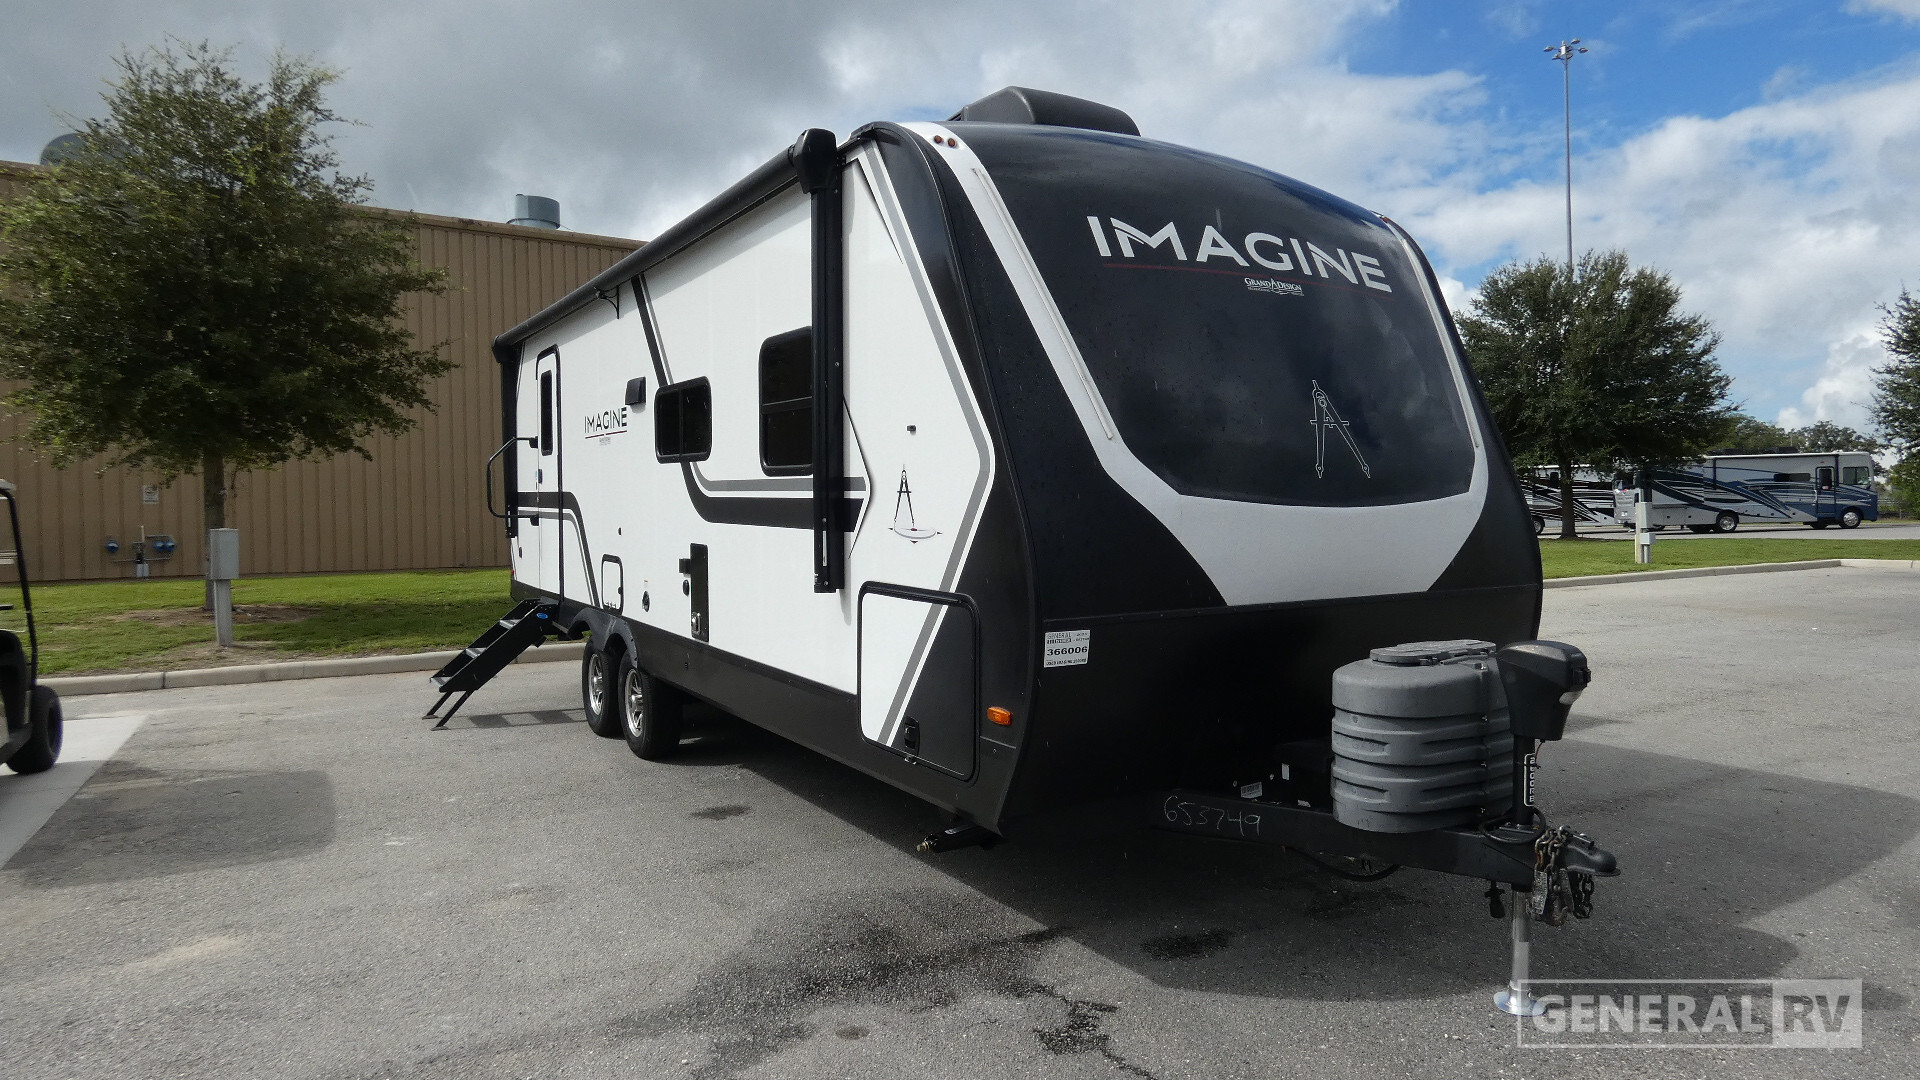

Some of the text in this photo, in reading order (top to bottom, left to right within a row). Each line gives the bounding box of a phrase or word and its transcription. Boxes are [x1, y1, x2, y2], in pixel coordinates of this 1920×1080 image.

[1086, 215, 1393, 293] IMAGINE
[585, 407, 627, 433] IMAGINE
[1047, 646, 1087, 655] 366006
